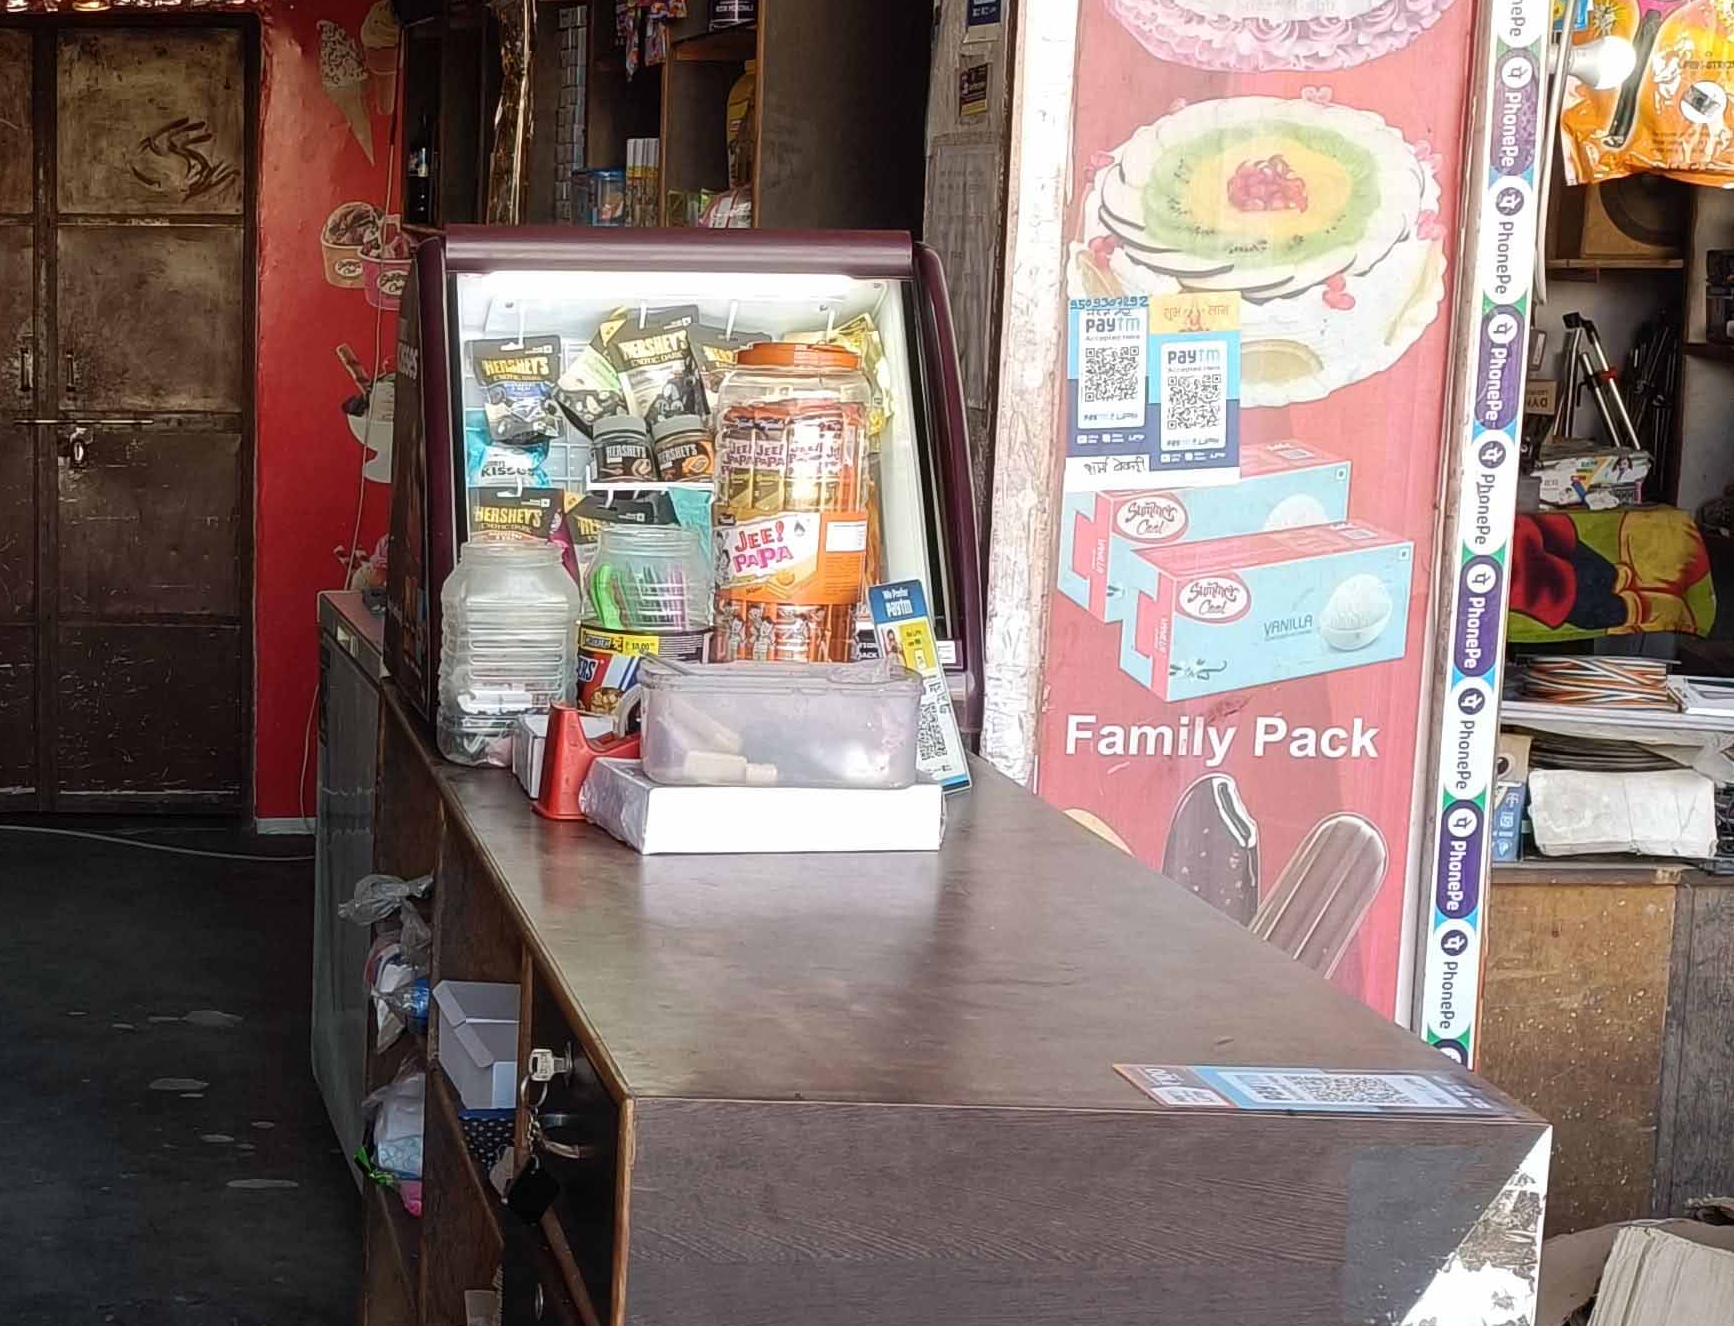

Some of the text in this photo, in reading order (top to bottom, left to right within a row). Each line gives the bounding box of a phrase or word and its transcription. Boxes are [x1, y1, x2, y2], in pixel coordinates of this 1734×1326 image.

[1501, 91, 1523, 169] PhonePe
[1495, 221, 1515, 296] PhonePe
[1485, 346, 1508, 423] PhonePe
[734, 520, 785, 553] JEE!
[1124, 501, 1178, 523] Summer
[1475, 474, 1496, 546] PhonePe
[732, 545, 795, 573] PAPA
[1186, 580, 1240, 603] Summer
[1263, 614, 1314, 636] VANILLA
[1464, 597, 1486, 669] PhonePe
[1065, 711, 1381, 768] Family Pack
[1456, 720, 1476, 790] PhonePe
[1446, 840, 1467, 912] PhonePe
[1439, 960, 1459, 1030] PhonePe
